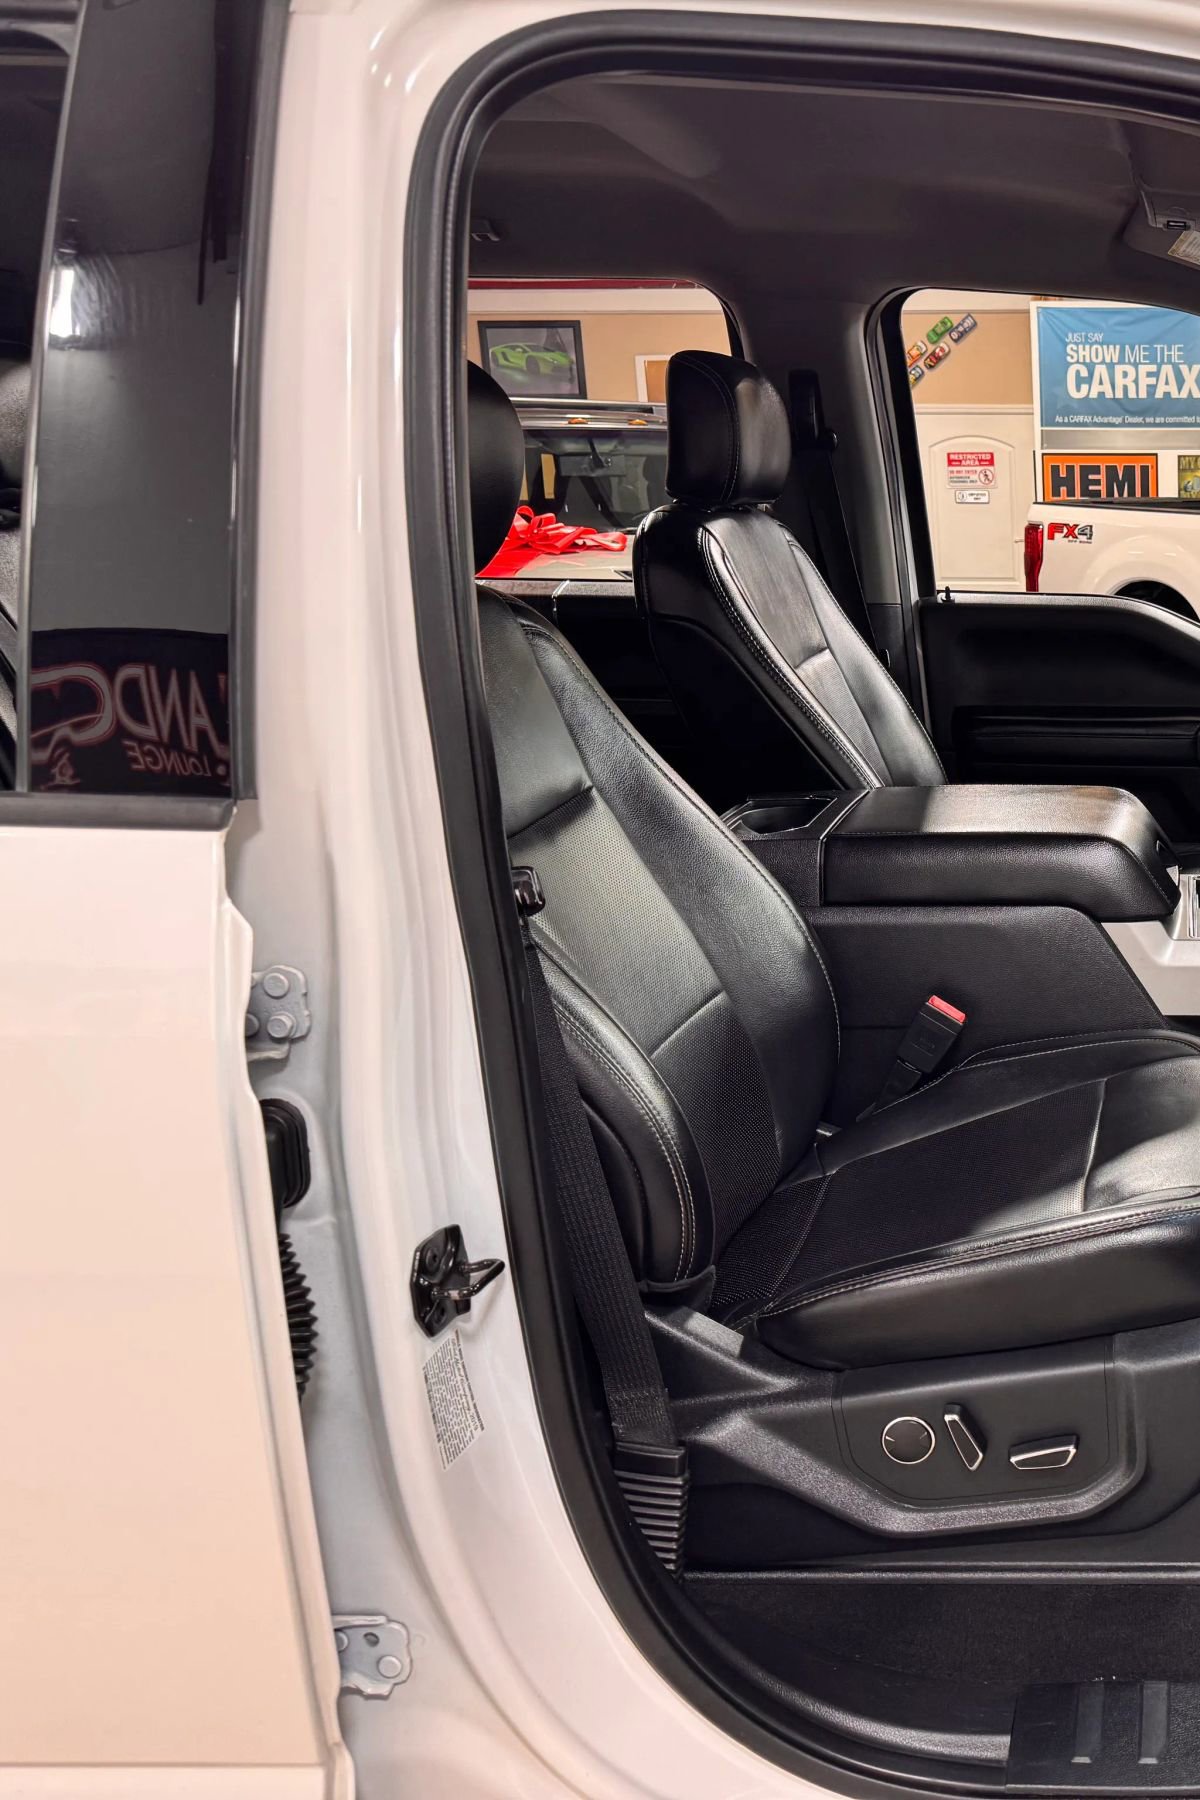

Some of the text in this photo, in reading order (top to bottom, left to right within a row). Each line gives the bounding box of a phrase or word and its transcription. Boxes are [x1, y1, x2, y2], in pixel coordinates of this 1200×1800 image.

[1066, 333, 1103, 342] JUST SAY
[1067, 345, 1184, 363] SHOW ME THE
[949, 453, 991, 461] RESTRICTED
[1180, 457, 1195, 469] MY
[1050, 464, 1150, 498] HEMI
[1047, 523, 1093, 540] FX4
